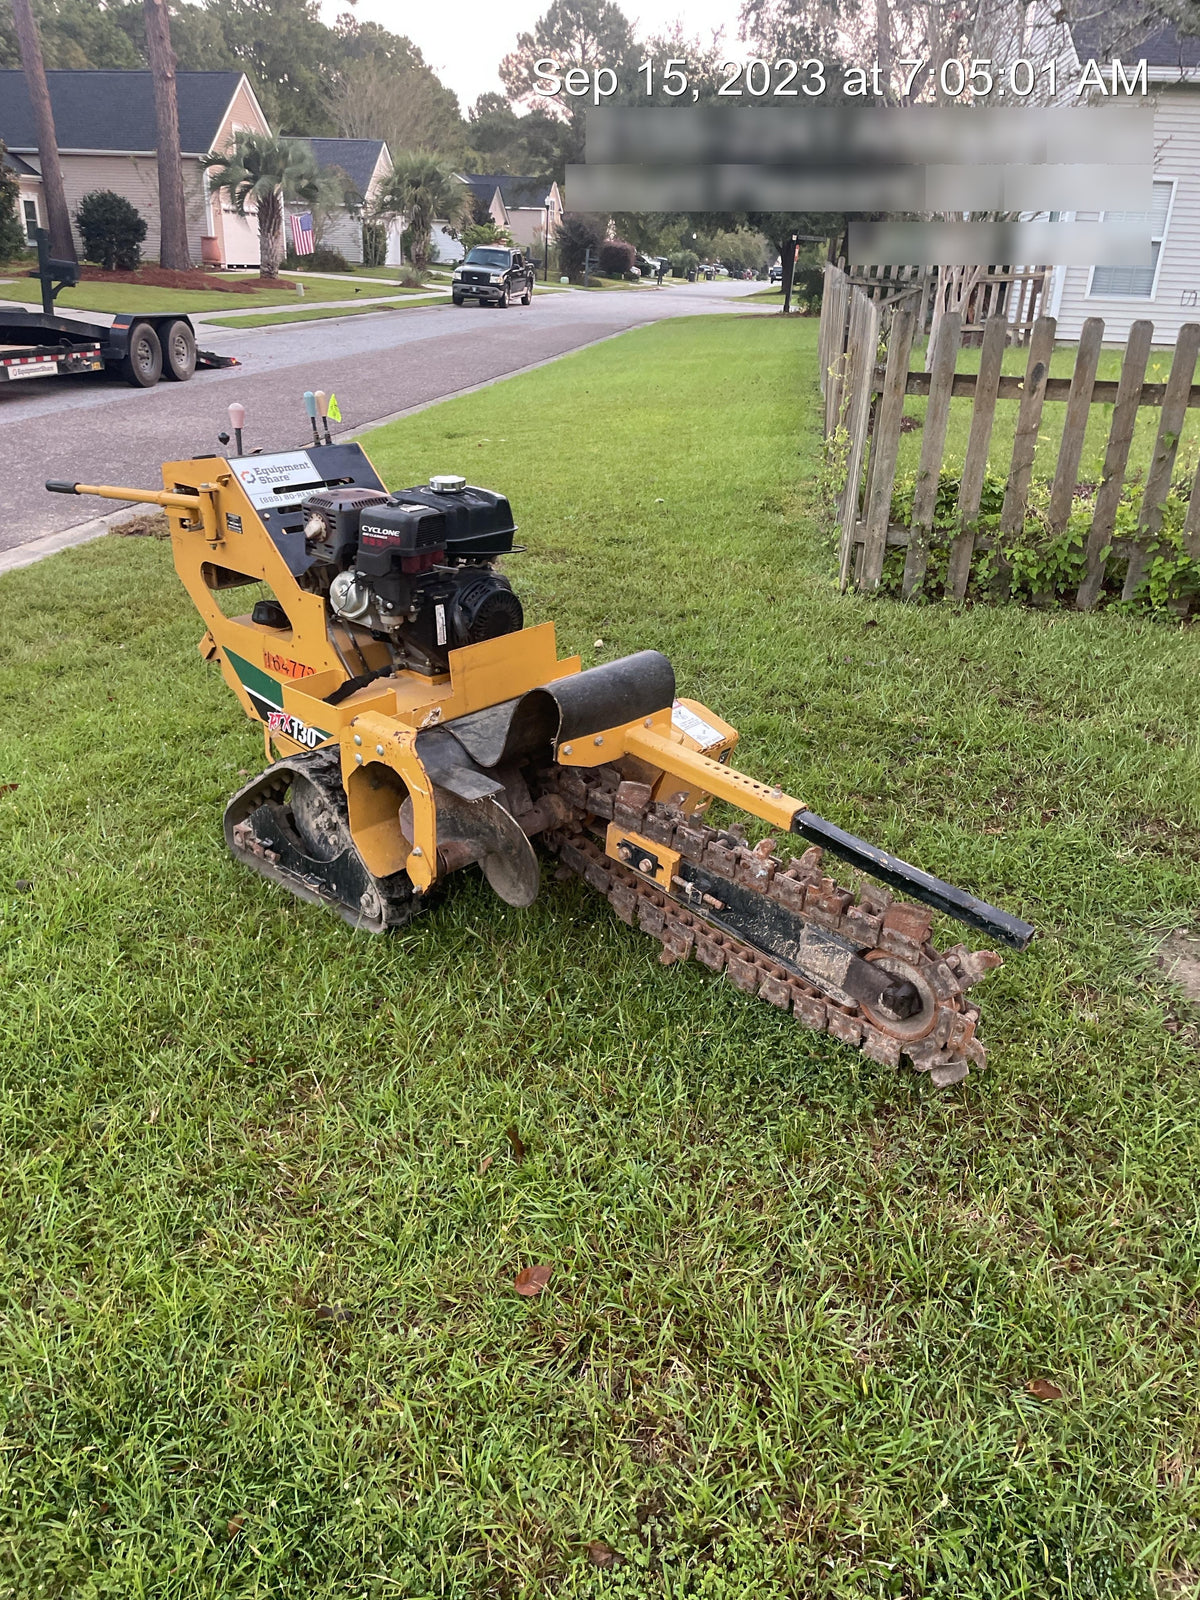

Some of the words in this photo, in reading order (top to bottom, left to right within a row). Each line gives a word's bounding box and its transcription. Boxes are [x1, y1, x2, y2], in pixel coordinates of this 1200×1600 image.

[253, 462, 311, 476] Equipment
[258, 474, 290, 484] Share
[362, 525, 400, 537] CYCLONE
